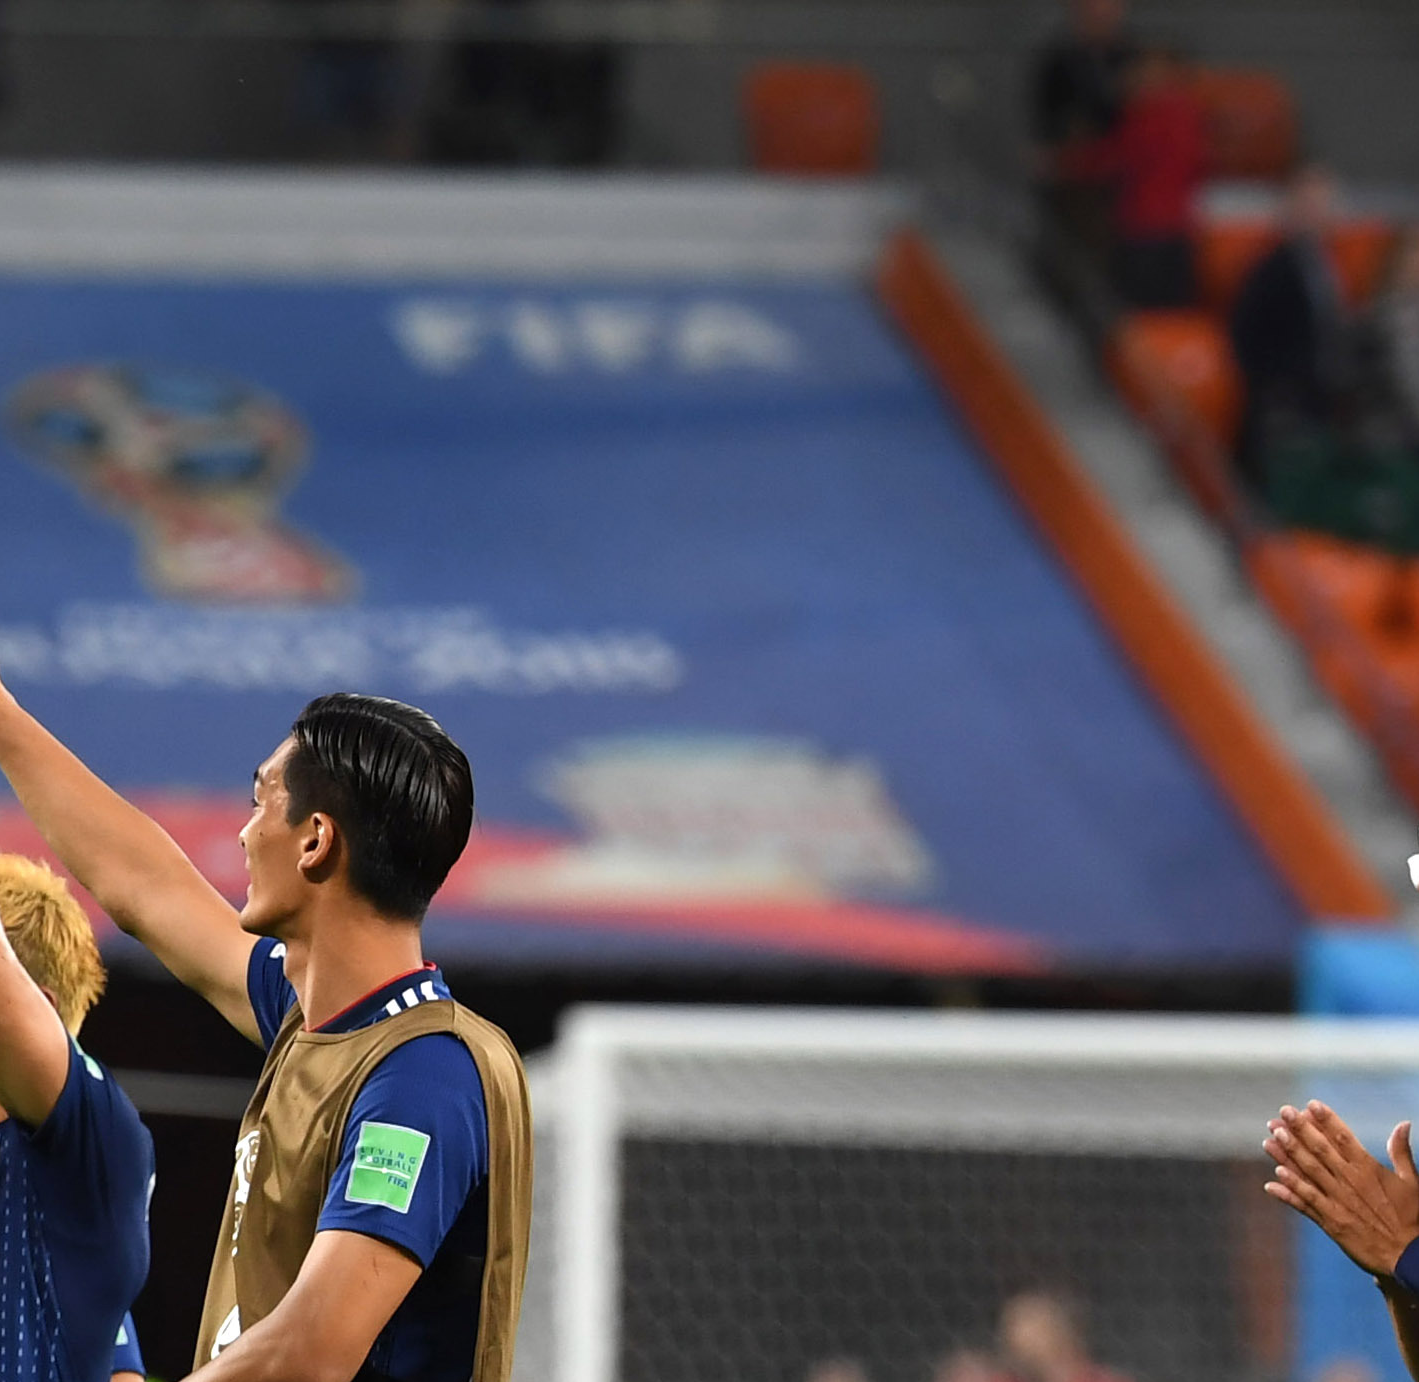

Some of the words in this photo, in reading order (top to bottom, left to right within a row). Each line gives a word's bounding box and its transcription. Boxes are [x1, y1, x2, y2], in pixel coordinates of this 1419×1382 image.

[359, 1154, 413, 1173] FOOTBALL
[360, 1146, 417, 1165] LIVING
[387, 1175, 409, 1190] FIFA
